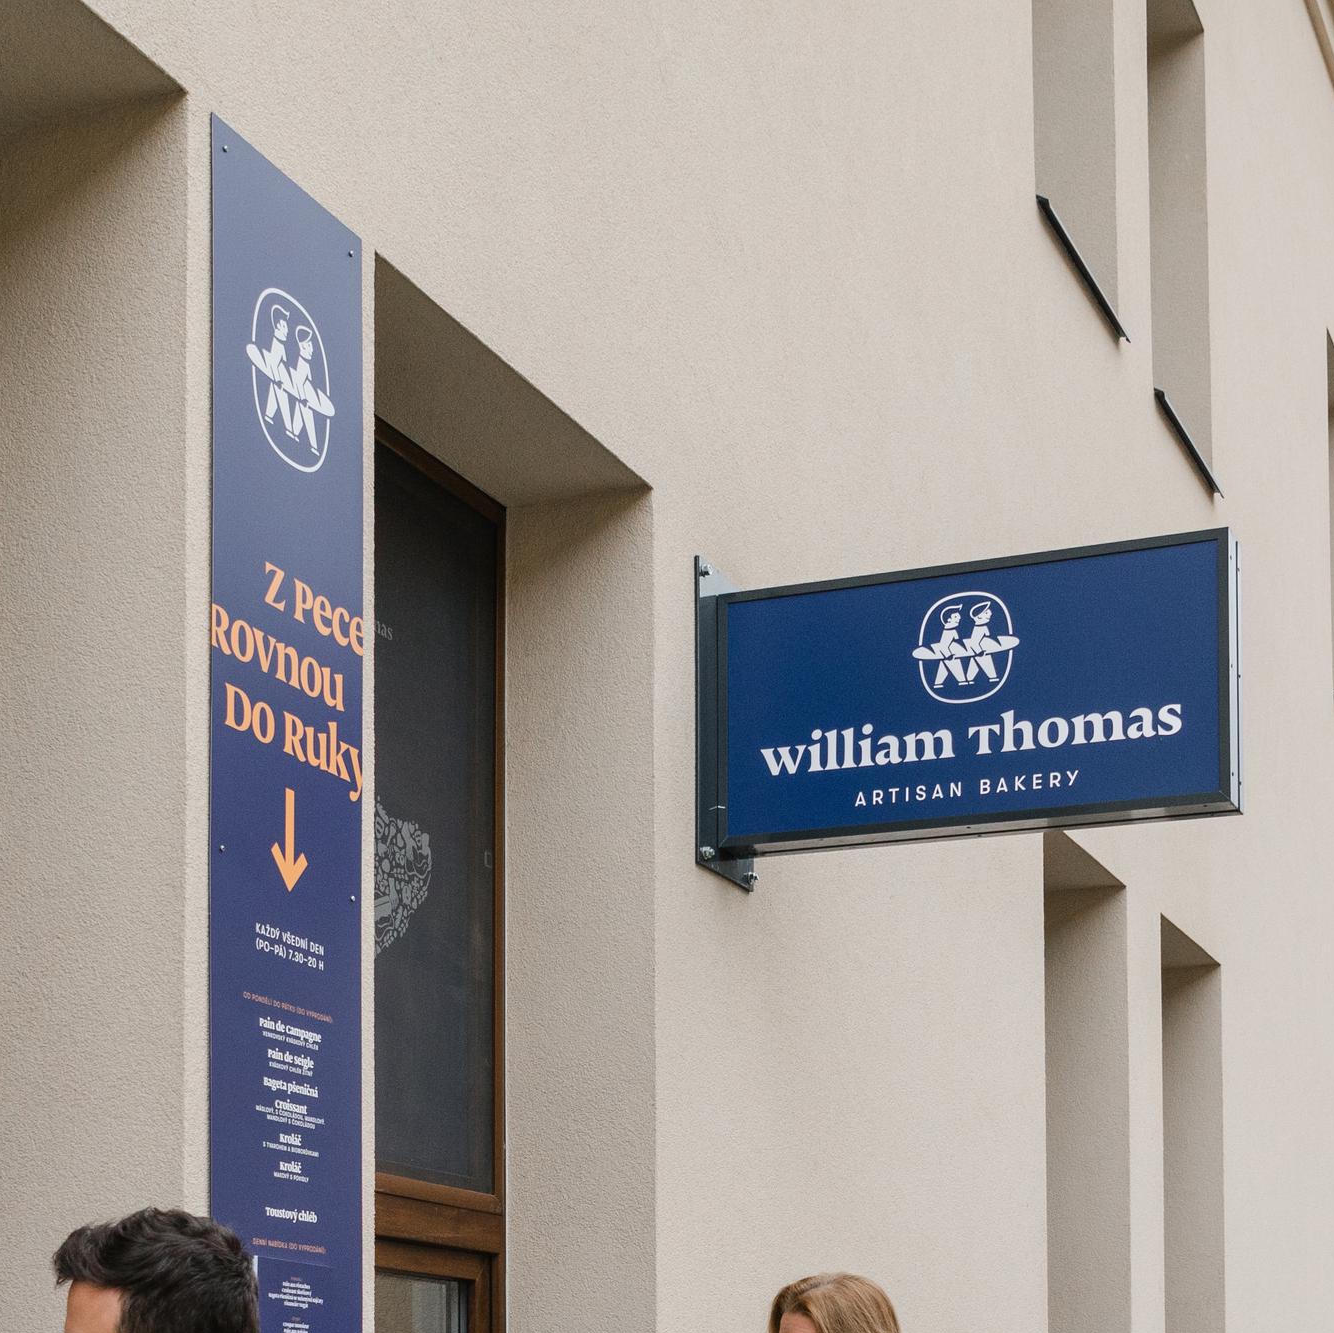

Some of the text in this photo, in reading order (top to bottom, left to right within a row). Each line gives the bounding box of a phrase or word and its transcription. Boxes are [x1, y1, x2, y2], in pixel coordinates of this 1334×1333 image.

[265, 561, 286, 611] Z
[760, 703, 1183, 777] william Thomas
[854, 769, 1081, 807] ARTISAN BAKERY
[255, 922, 324, 956] KAŽDÝ VŠEDNÍ DEN
[319, 960, 324, 971] H
[259, 1016, 275, 1031] Pain
[276, 1020, 286, 1033] de
[267, 1048, 314, 1070] Pain de seigle
[263, 1076, 287, 1091] Bageta
[265, 1207, 318, 1224] Toustový chléb
